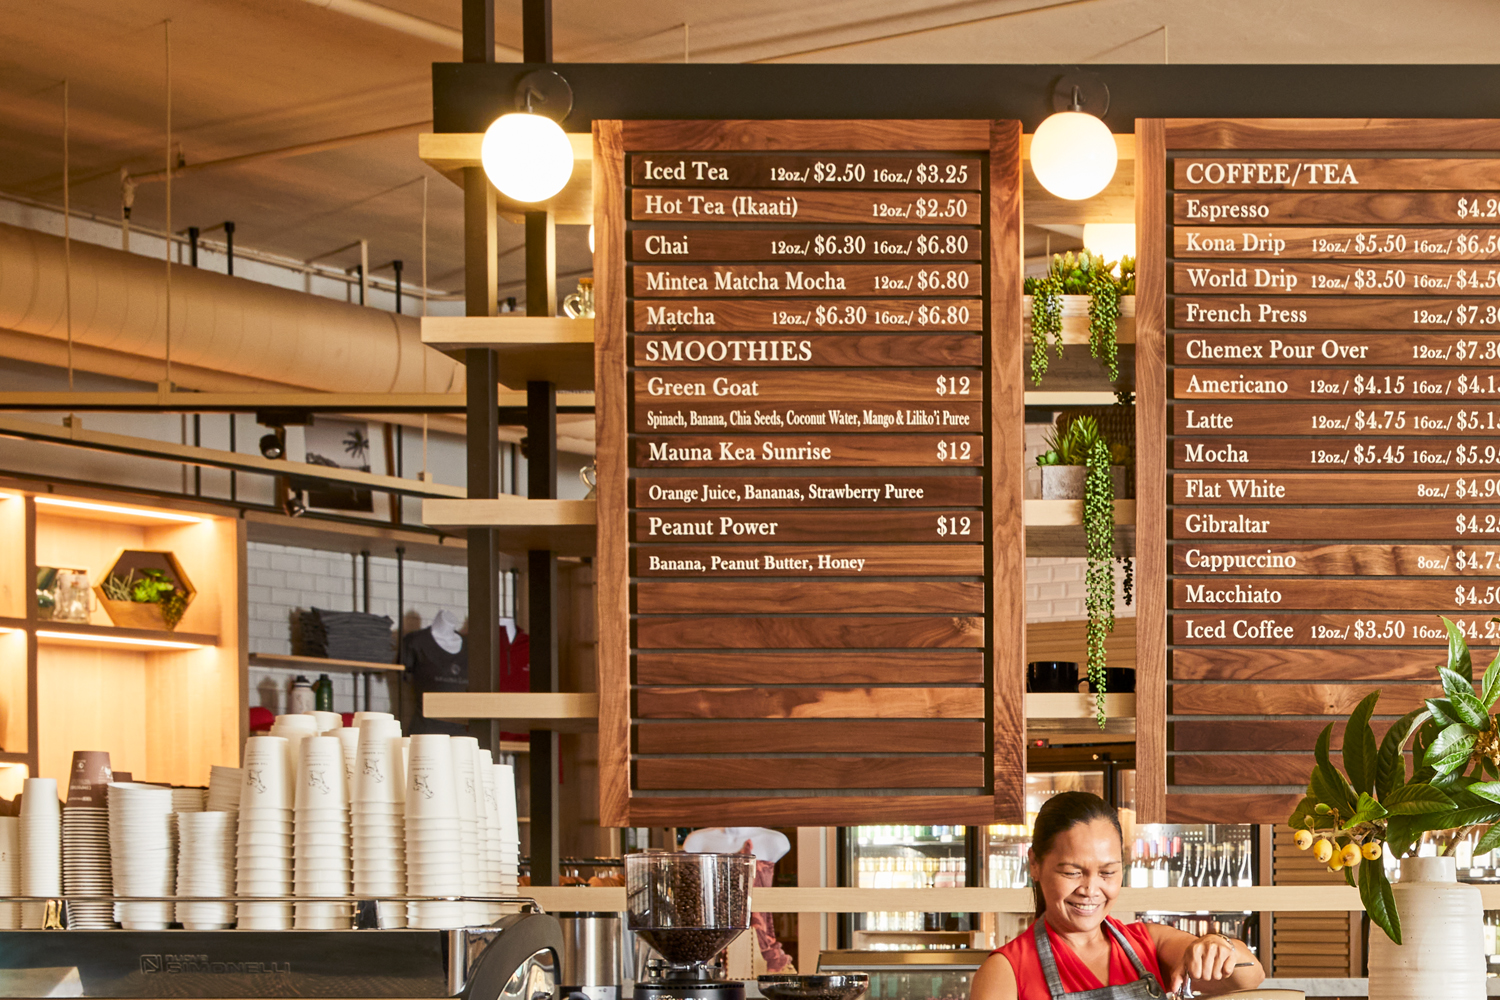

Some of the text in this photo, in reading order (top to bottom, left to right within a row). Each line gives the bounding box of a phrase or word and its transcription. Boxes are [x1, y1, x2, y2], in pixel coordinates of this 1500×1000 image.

[645, 160, 968, 185] Iced Tea 12oz./ $2.50 16oz./ $3.25
[1186, 162, 1360, 187] COFFEE/TEA
[645, 195, 968, 219] Hot Tea (Ikaati) 12oz./ $2.50
[1186, 199, 1270, 223] Espresso
[645, 234, 969, 256] Chai 12oz./ $6.30 16oz./ $6.80
[1185, 232, 1236, 252] Kona
[1241, 232, 1286, 256] Drip
[1312, 238, 1352, 254] 12oz./
[1354, 232, 1407, 255] $5.50
[1413, 239, 1453, 255] 16oz./
[646, 269, 969, 291] Mintea Matcha Mocha 12oz./ $6.80
[1186, 268, 1248, 288] World
[1254, 268, 1298, 292] Drip
[1311, 274, 1351, 290] 12oz./
[1353, 268, 1406, 291] $3.50
[1413, 274, 1453, 290] 16oz./
[646, 304, 970, 327] Matcha 12oz./ $6.30 16oz./ $6.80
[1186, 303, 1252, 323] French
[1258, 303, 1308, 323] Press
[1413, 309, 1453, 326] 12oz./
[645, 340, 812, 362] SMOOTHIES
[1186, 339, 1263, 359] Chemex
[1269, 339, 1316, 359] Pour
[1321, 339, 1369, 359] Over
[1412, 344, 1453, 361] 12oz./
[647, 374, 970, 397] Green Goat $12
[1185, 374, 1289, 394] Americano
[1353, 373, 1405, 396] $4.15
[647, 410, 688, 430] Spinach,
[690, 410, 728, 428] Banana,
[729, 410, 752, 426] Chia
[753, 409, 784, 427] Seeds,
[786, 409, 826, 426] Coconut
[828, 409, 861, 427] Water,
[862, 409, 895, 429] Mango
[942, 410, 970, 426] Puree
[1185, 409, 1234, 429] Latte
[1311, 415, 1351, 431] 12oz./
[1354, 409, 1406, 431] $4.75
[1413, 415, 1453, 431] 16oz./
[649, 439, 971, 462] Mauna Kea Sunrise $12
[1184, 443, 1250, 463] Mocha
[1310, 449, 1350, 465] 12oz./
[1353, 443, 1405, 466] $5.45
[1413, 450, 1452, 466] 16oz./
[648, 483, 924, 503] Orange Juice, Bananas, Strawberry Puree
[1185, 479, 1222, 498] Flat
[1226, 479, 1286, 499] White
[1417, 483, 1450, 499] 8oz./
[648, 515, 971, 537] Peanut Power $12
[1185, 513, 1271, 534] Gibraltar
[649, 554, 866, 572] Banana, Peanut Butter, Honey
[1185, 548, 1297, 573] Cappuccino
[1417, 555, 1450, 571] 8oz./
[1185, 584, 1282, 604] Macchiato
[1185, 619, 1227, 639] Iced
[1232, 619, 1294, 639] Coffee
[1311, 624, 1351, 641] 12oz./
[1353, 618, 1406, 641] $3.50
[166, 961, 292, 974] SIMONELLI
